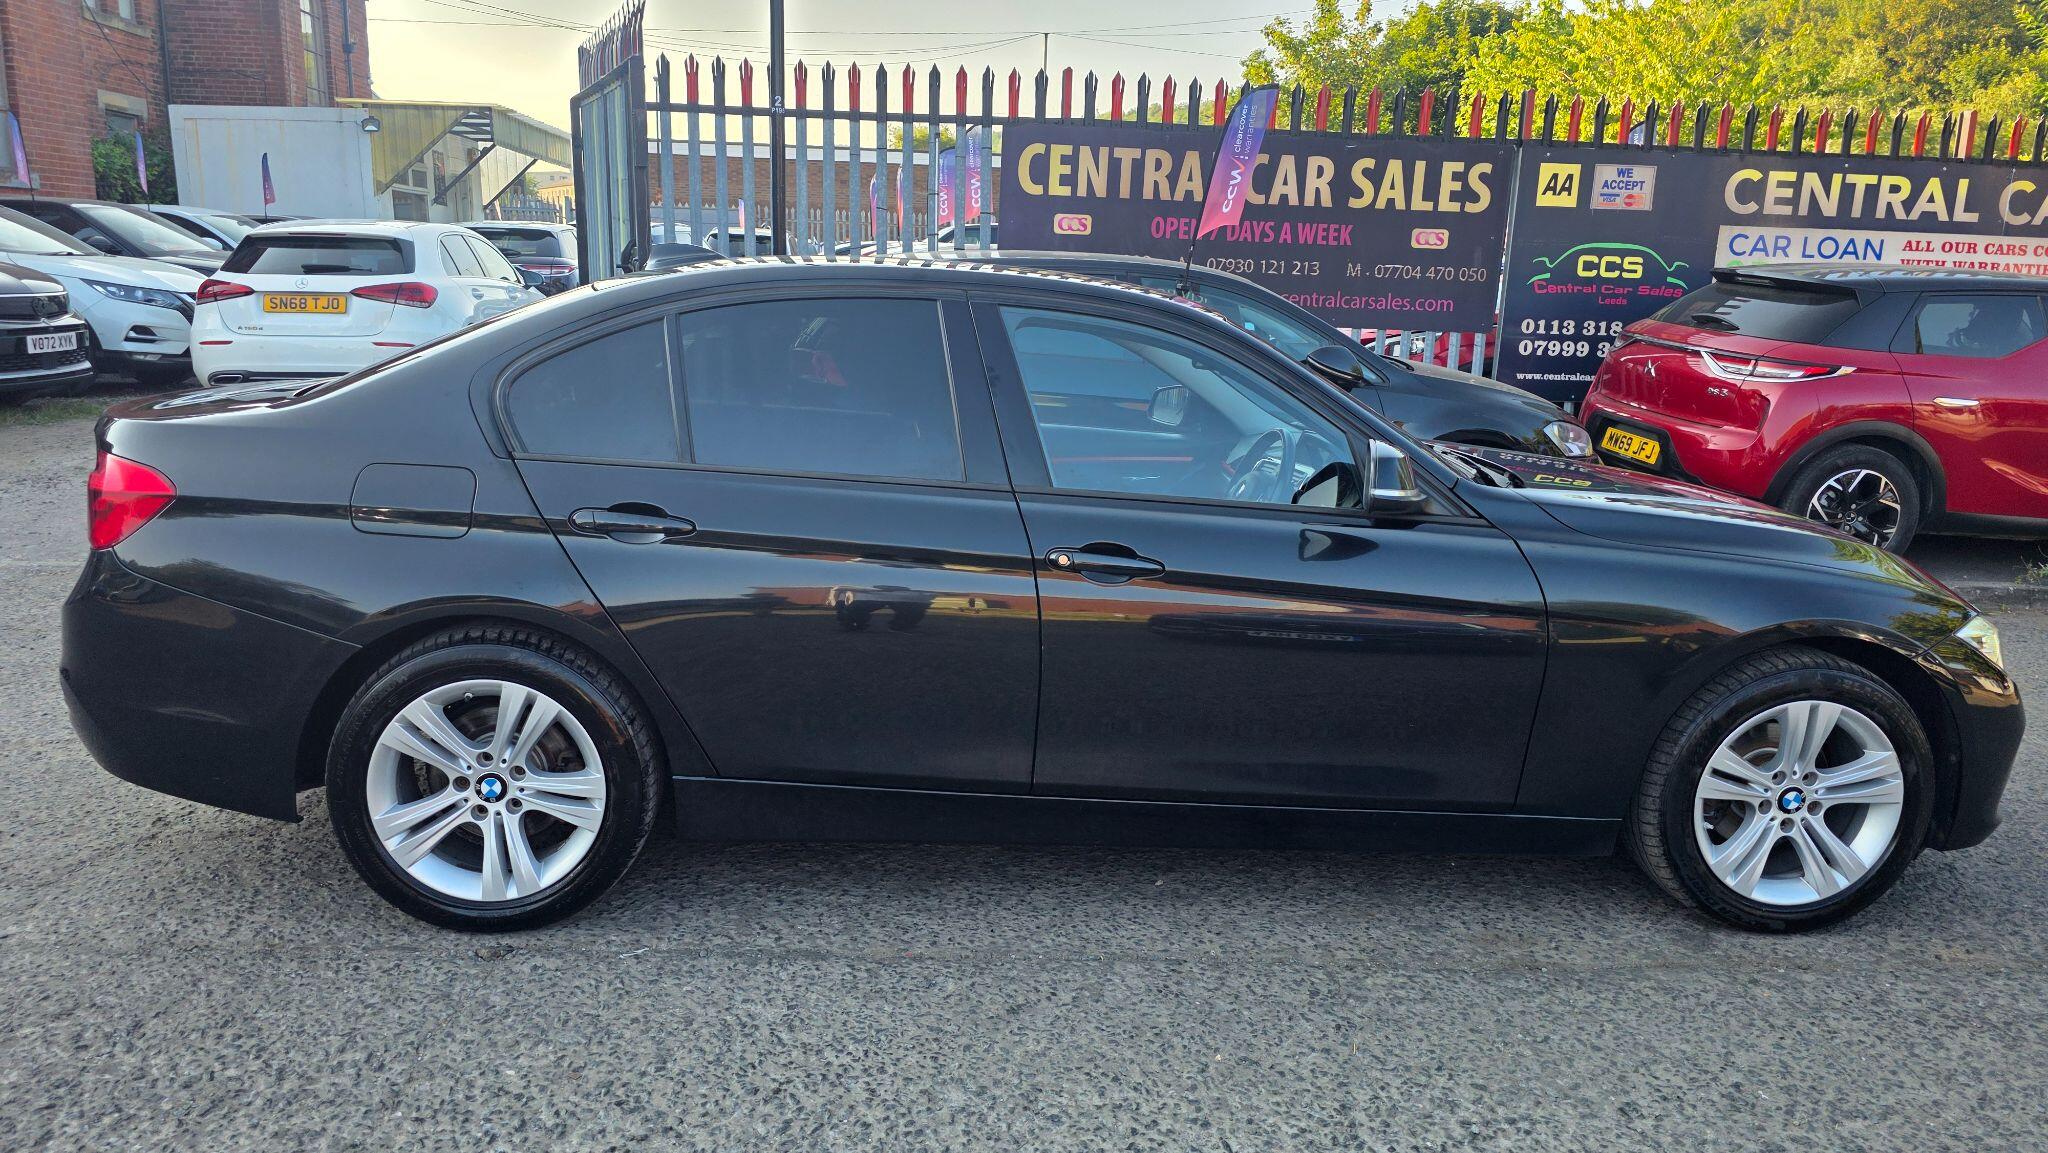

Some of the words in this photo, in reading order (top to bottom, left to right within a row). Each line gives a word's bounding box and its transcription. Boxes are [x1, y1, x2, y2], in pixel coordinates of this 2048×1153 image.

[774, 95, 782, 107] 2
[1234, 104, 1248, 153] clearcover
[1245, 105, 1258, 154] warranties
[1018, 142, 1215, 202] CENTRA
[1246, 153, 1335, 208] CAR
[1348, 157, 1493, 214] SALES
[1616, 167, 1634, 179] WE
[1541, 172, 1574, 197] AA
[1601, 179, 1645, 191] ACCEPT
[1724, 168, 1980, 223] CENTRAL
[1226, 219, 1275, 243] DAYS
[1279, 222, 1292, 244] A
[1297, 222, 1354, 246] WEEK
[1728, 233, 1792, 258] CAR
[1801, 236, 1885, 262] LOAN
[1902, 239, 1935, 252] ALL
[1941, 241, 1978, 254] OUR
[1984, 243, 2028, 257] CARS
[1206, 257, 1254, 273] 07930
[1261, 260, 1285, 274] 121
[1292, 261, 1320, 276] 213
[1374, 264, 1422, 280] 07704
[1426, 266, 1454, 281] 470
[1459, 267, 1487, 282] 050
[1576, 254, 1644, 279] CCS
[1533, 280, 1597, 294] Central
[1601, 285, 1633, 295] Car
[1637, 285, 1683, 298] Sales
[269, 296, 308, 310] SN68
[310, 297, 340, 310] TJO
[1598, 296, 1627, 305] Leeds
[1521, 318, 1576, 335] 0113
[1582, 320, 1623, 337] 318
[57, 334, 74, 349] XYK
[1518, 339, 1590, 358] 07999
[1606, 431, 1632, 452] MW69
[1633, 439, 1657, 460] JFJ
